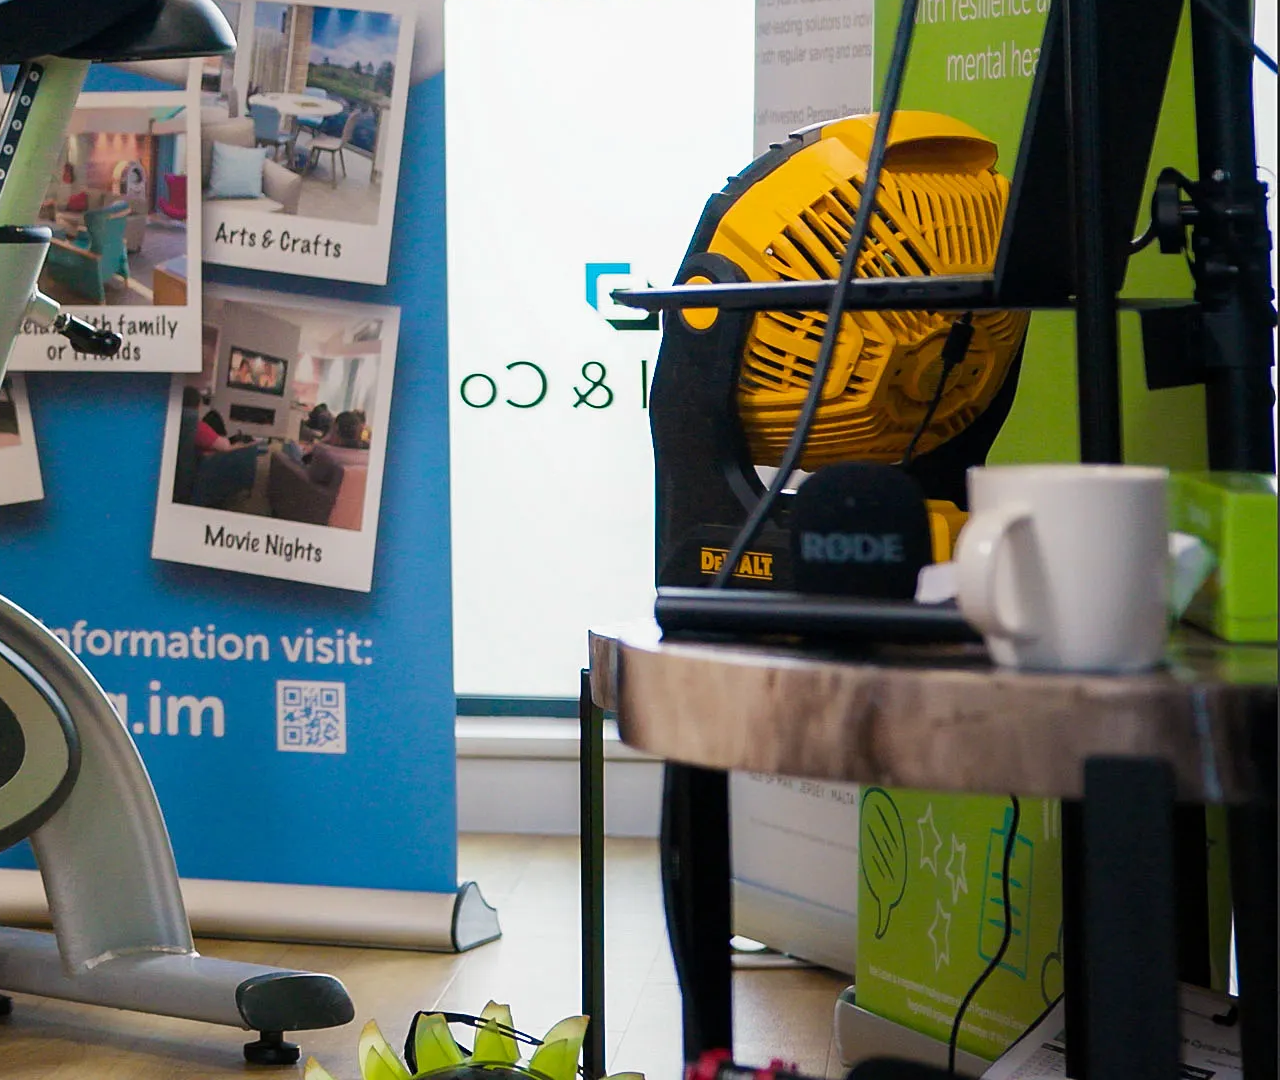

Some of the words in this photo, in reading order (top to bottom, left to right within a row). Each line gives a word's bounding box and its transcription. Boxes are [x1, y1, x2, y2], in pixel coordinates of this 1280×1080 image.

[946, 40, 1007, 83] mental
[215, 222, 257, 248] Arts
[262, 229, 275, 249] &
[280, 230, 342, 258] Crafts
[119, 313, 179, 339] family
[47, 343, 68, 361] or
[204, 524, 260, 553] Movie
[265, 534, 323, 563] Nights
[701, 550, 773, 577] DEALT
[44, 619, 270, 662] nformation
[279, 627, 373, 666] visit:
